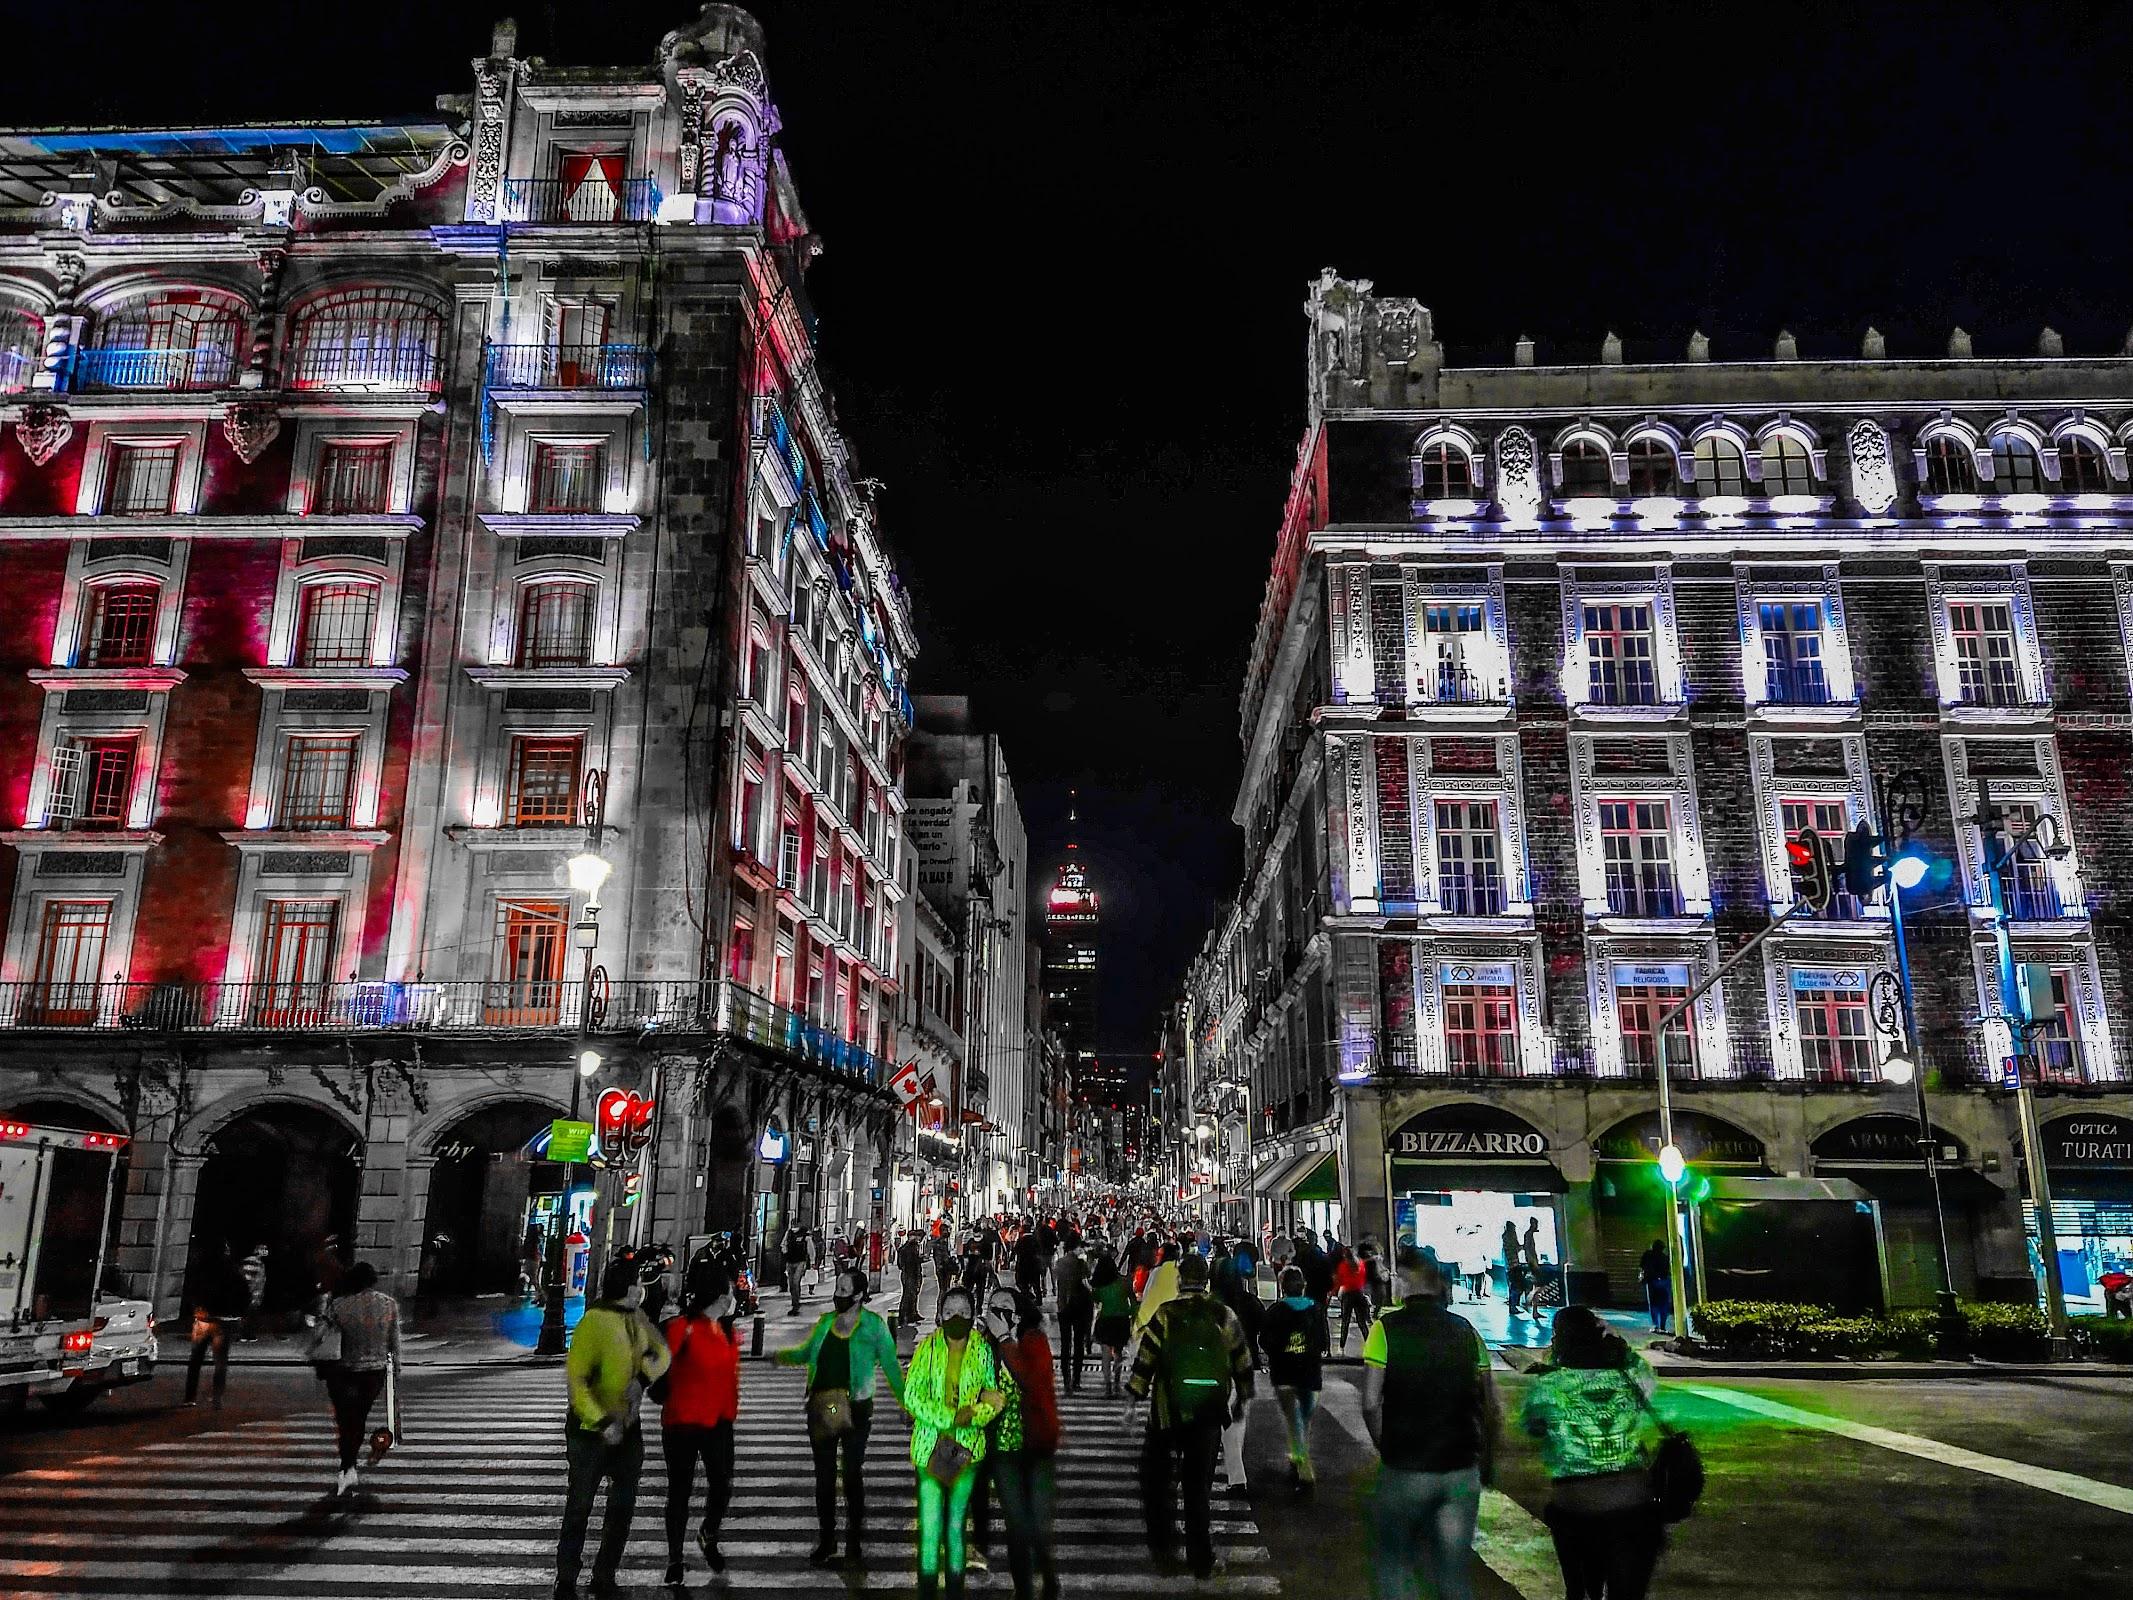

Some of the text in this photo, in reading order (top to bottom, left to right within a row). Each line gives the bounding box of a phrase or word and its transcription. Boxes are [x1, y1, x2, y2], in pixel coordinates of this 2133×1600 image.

[919, 819, 950, 827] verdad
[931, 831, 943, 839] un
[2069, 1123, 2118, 1135] OPTICA
[1399, 1132, 1545, 1155] BIZZARRO
[2061, 1142, 2132, 1159] TURATI
[436, 1141, 476, 1163] rby
